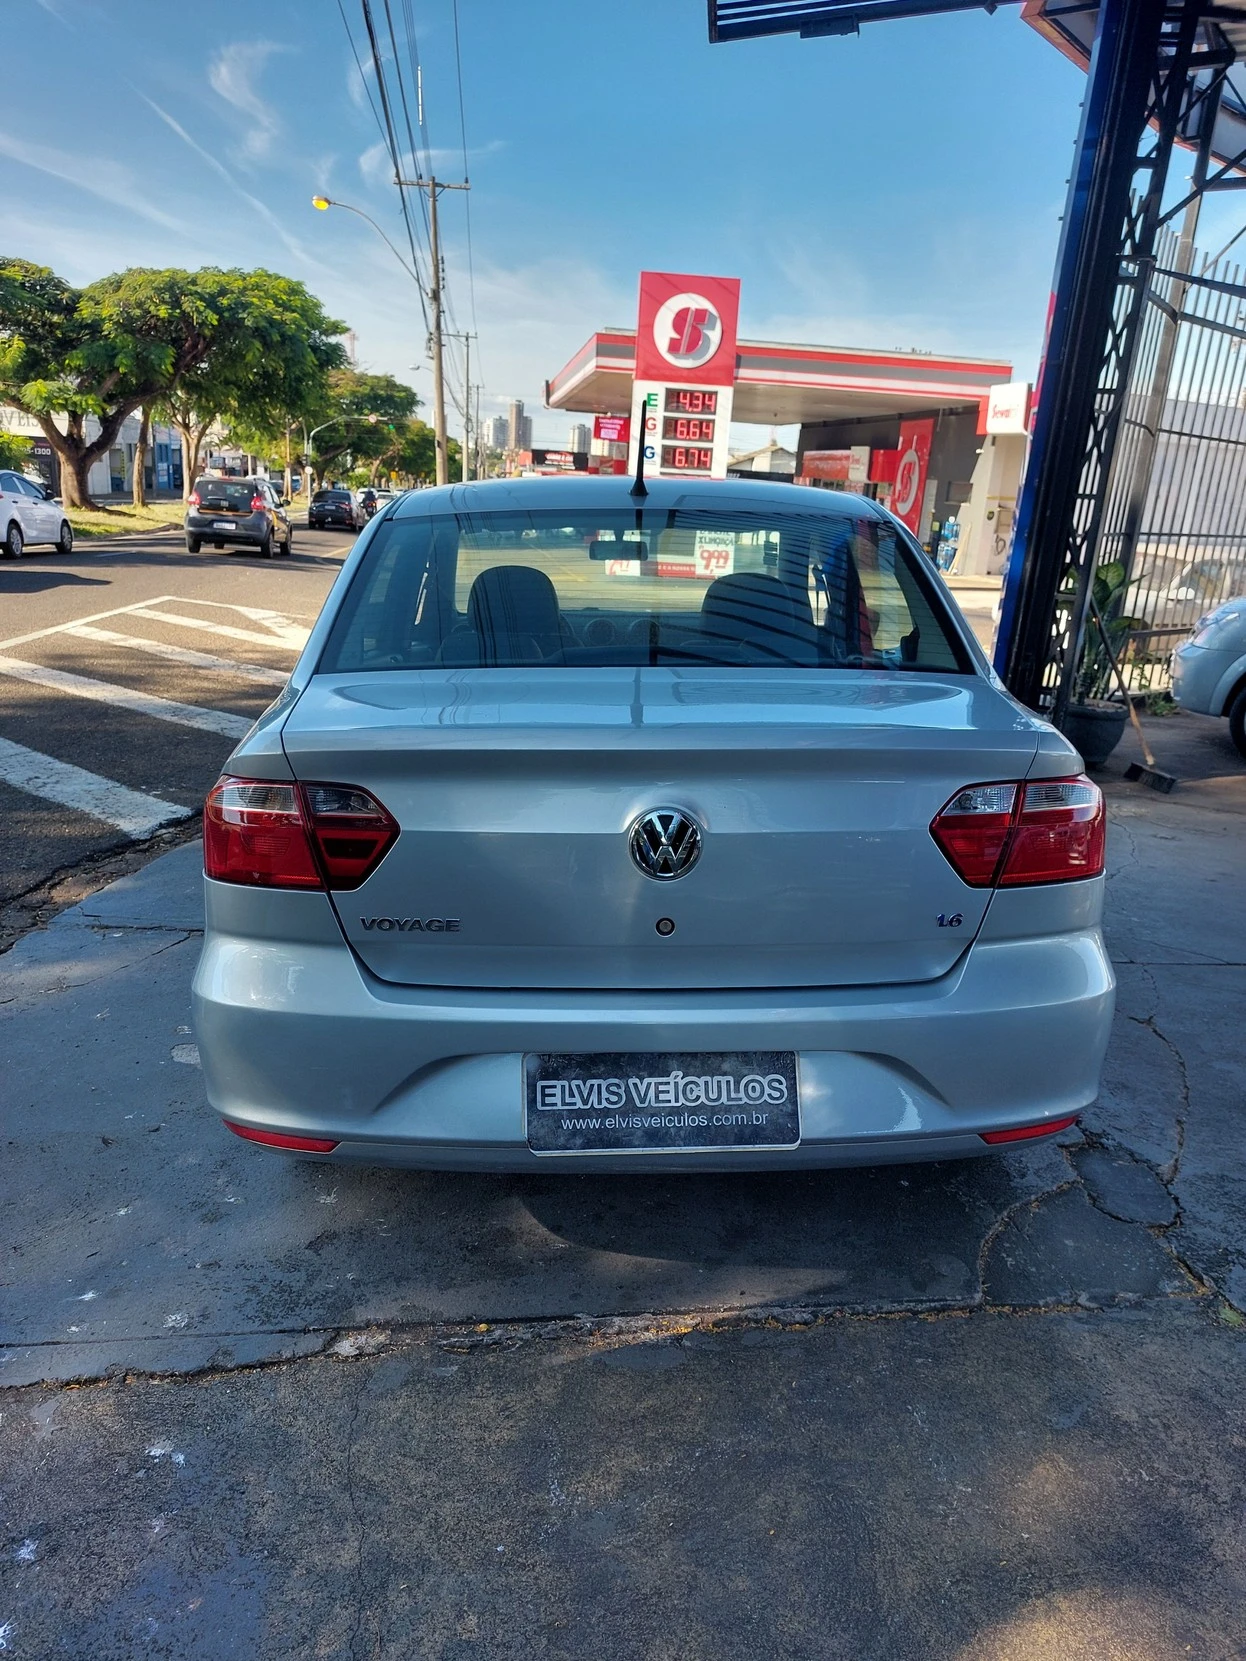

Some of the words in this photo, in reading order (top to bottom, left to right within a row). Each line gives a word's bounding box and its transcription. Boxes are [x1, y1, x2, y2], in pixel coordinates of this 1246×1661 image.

[646, 393, 658, 407] E
[645, 417, 657, 431] G
[643, 446, 655, 459] G
[360, 917, 460, 932] VOYAGE
[537, 1078, 626, 1111] ELVIS
[628, 1070, 788, 1108] VEÍCULOS
[561, 1111, 769, 1130] www.elvisveiculos.com.br
